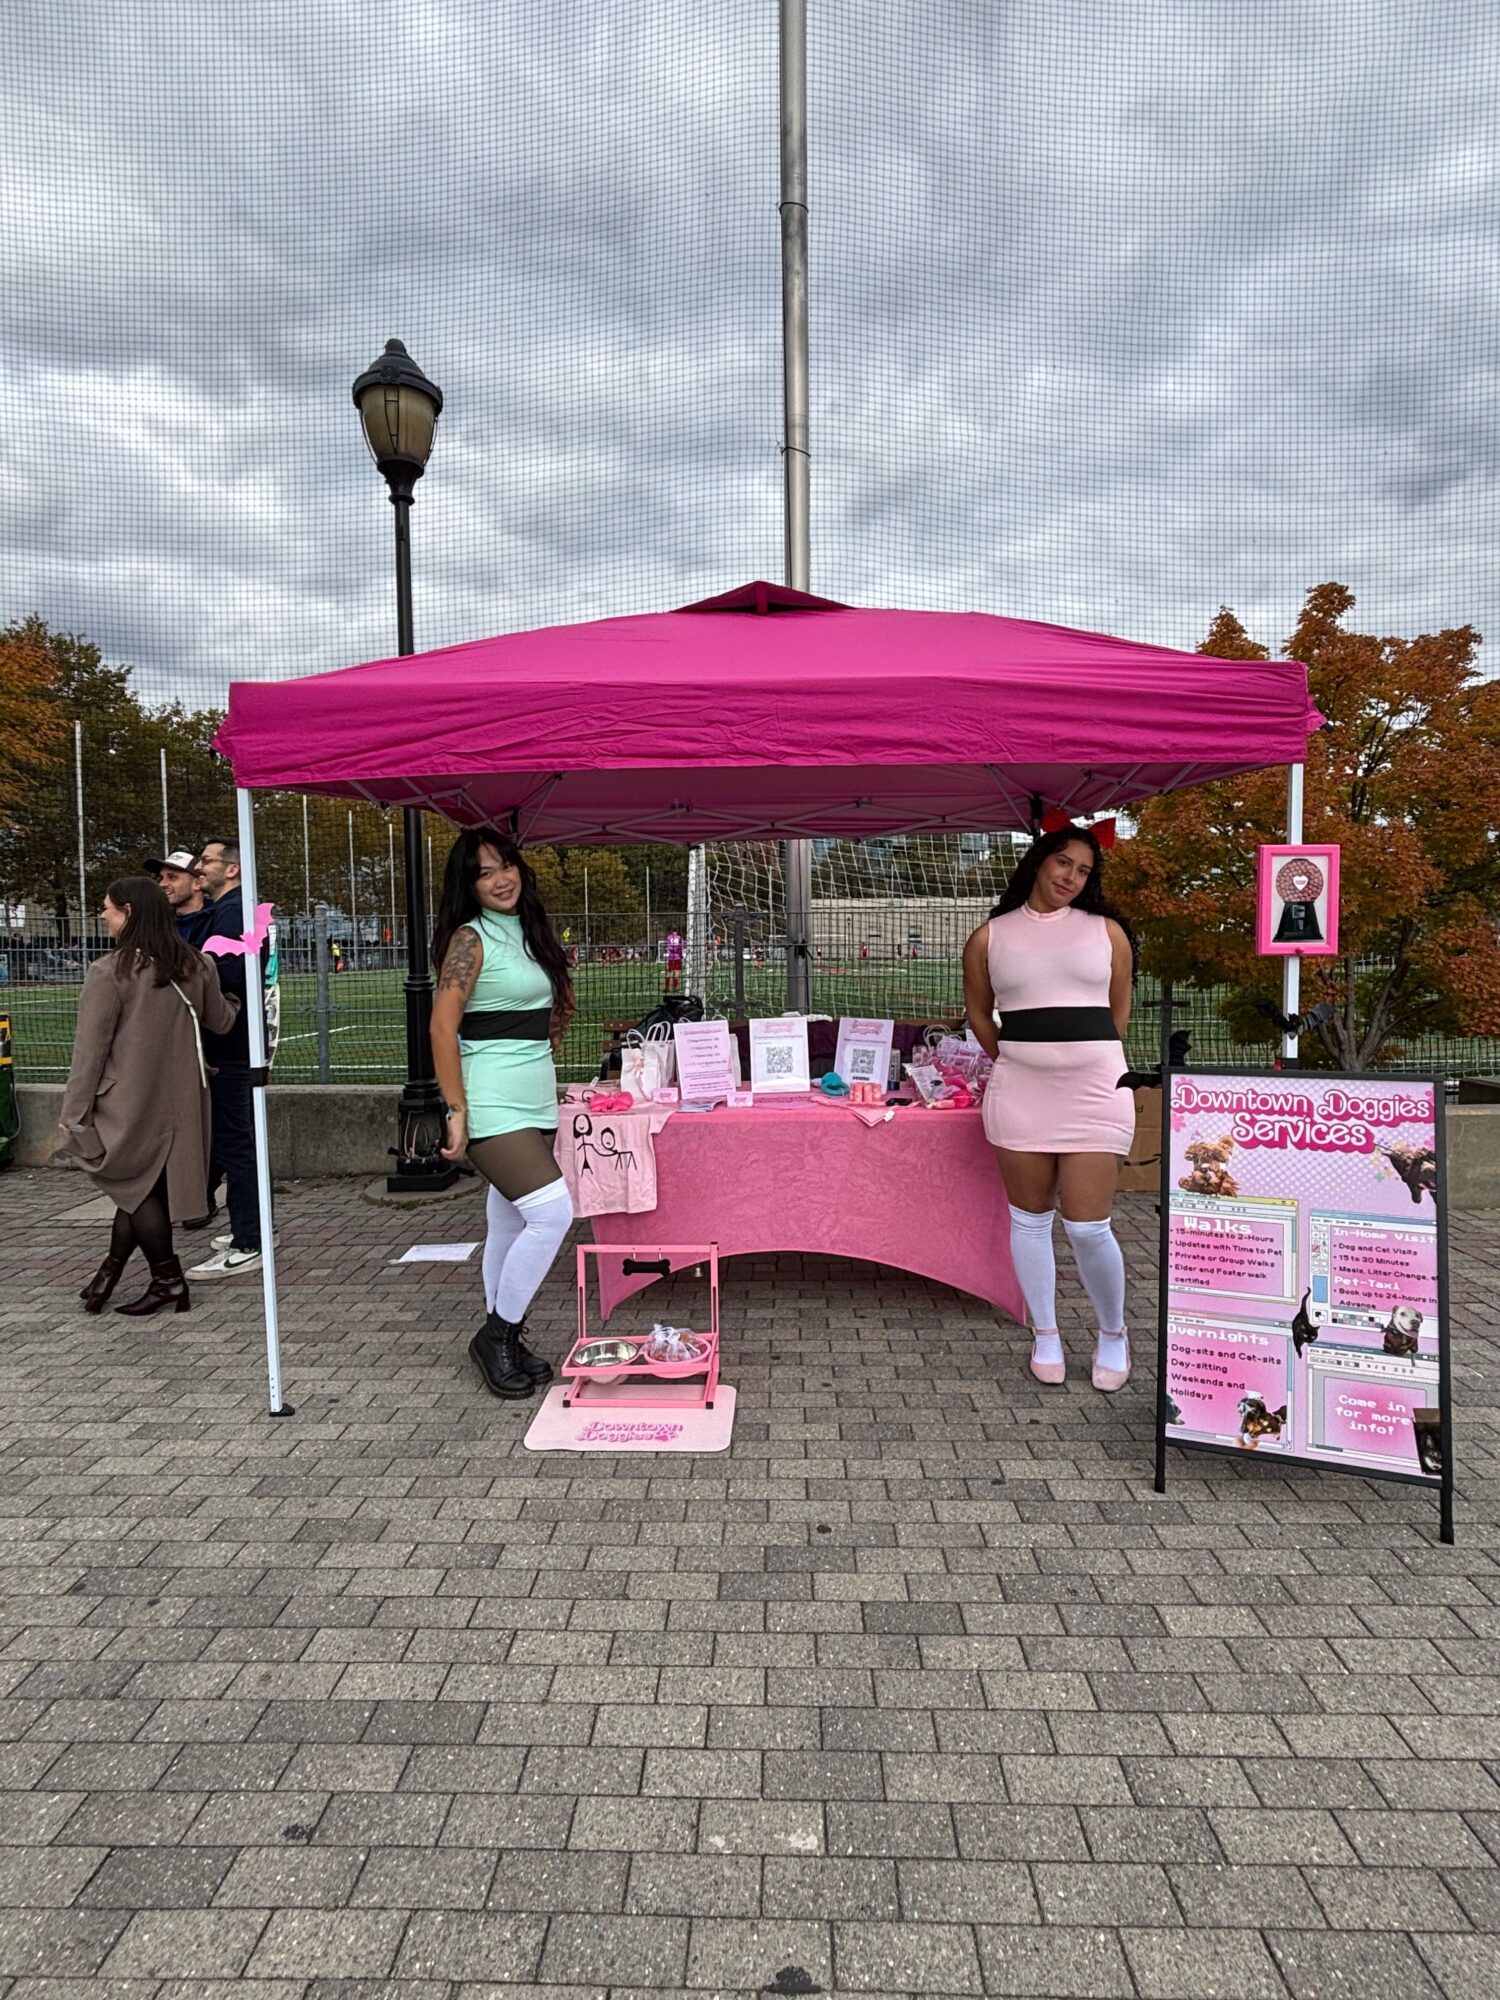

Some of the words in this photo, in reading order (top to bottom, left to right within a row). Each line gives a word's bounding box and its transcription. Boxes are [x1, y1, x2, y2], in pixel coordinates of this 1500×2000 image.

[1171, 1084, 1312, 1115] Downtown
[1317, 1089, 1432, 1124] Doggies
[1232, 1112, 1371, 1149] Services
[1183, 1216, 1252, 1234] Walks
[1175, 1228, 1224, 1238] 15-minutes
[1237, 1234, 1274, 1243] 2-Hours
[1334, 1229, 1388, 1240] In-Home
[1175, 1240, 1211, 1249] Updates
[1232, 1245, 1254, 1253] Time
[1338, 1243, 1356, 1252] Dog
[1358, 1244, 1373, 1252] and
[1393, 1248, 1418, 1256] Visits
[1175, 1252, 1205, 1261] Private
[1219, 1256, 1245, 1265] Group
[1247, 1259, 1275, 1268] Walks
[1376, 1258, 1410, 1267] Minutes
[1175, 1264, 1197, 1272] Elder
[1199, 1266, 1215, 1274] and
[1217, 1268, 1246, 1277] Foster
[1248, 1272, 1267, 1280] walk
[1175, 1277, 1210, 1286] certified
[1334, 1276, 1400, 1290] Pet-Taxi
[1339, 1288, 1359, 1296] Book
[1386, 1292, 1427, 1303] 24-hours
[1340, 1300, 1376, 1309] Advance
[1167, 1323, 1269, 1346] Overnights
[1171, 1344, 1214, 1356] Dog-sits
[1218, 1351, 1235, 1359] and
[1238, 1352, 1281, 1365] Cat-sits
[1171, 1358, 1228, 1374] Day-sitting
[1171, 1373, 1224, 1387] Weekends
[1227, 1382, 1245, 1390] and
[1170, 1388, 1213, 1400] Holidays
[1338, 1394, 1377, 1409] Come
[1387, 1401, 1406, 1413] in
[1335, 1406, 1362, 1419] for
[1371, 1412, 1411, 1426] more
[584, 1422, 683, 1432] Downtown
[1349, 1421, 1395, 1436] info!
[575, 1431, 654, 1442] Doggies
